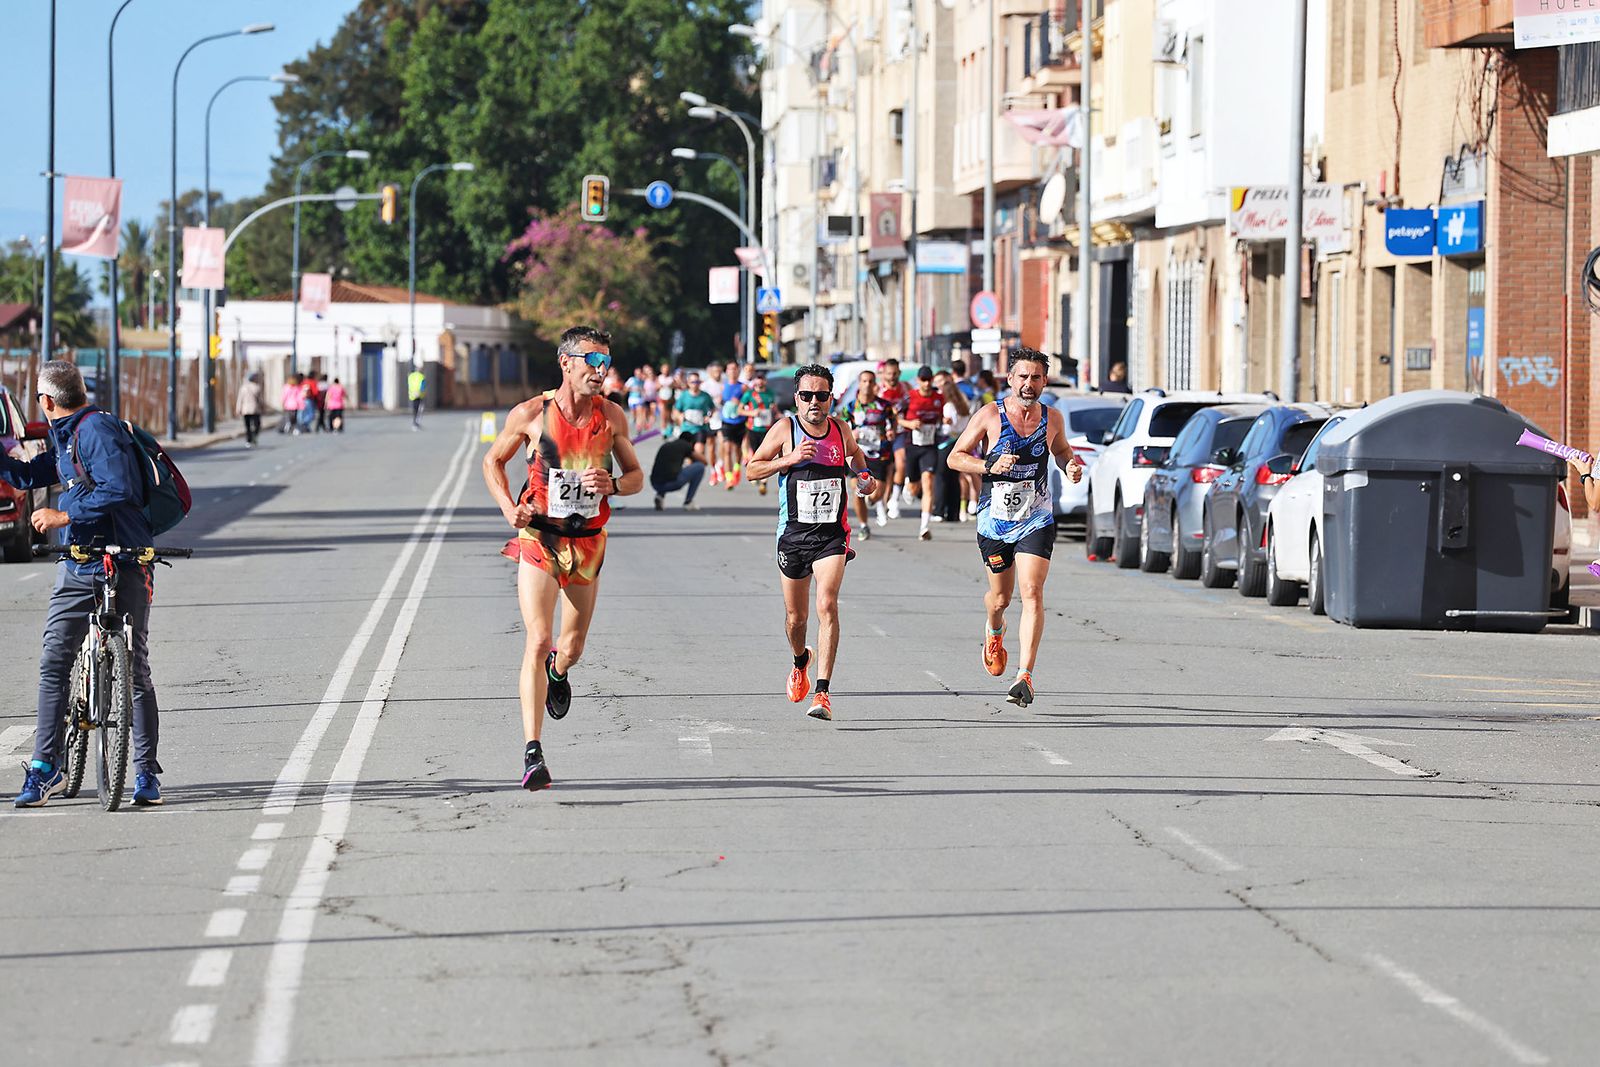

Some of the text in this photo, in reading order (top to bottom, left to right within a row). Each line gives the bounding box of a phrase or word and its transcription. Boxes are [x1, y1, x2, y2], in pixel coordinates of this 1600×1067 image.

[830, 479, 840, 487] 2K
[1022, 481, 1032, 489] 2K
[560, 484, 596, 500] 214
[810, 491, 831, 507] 72
[1003, 492, 1022, 507] 55
